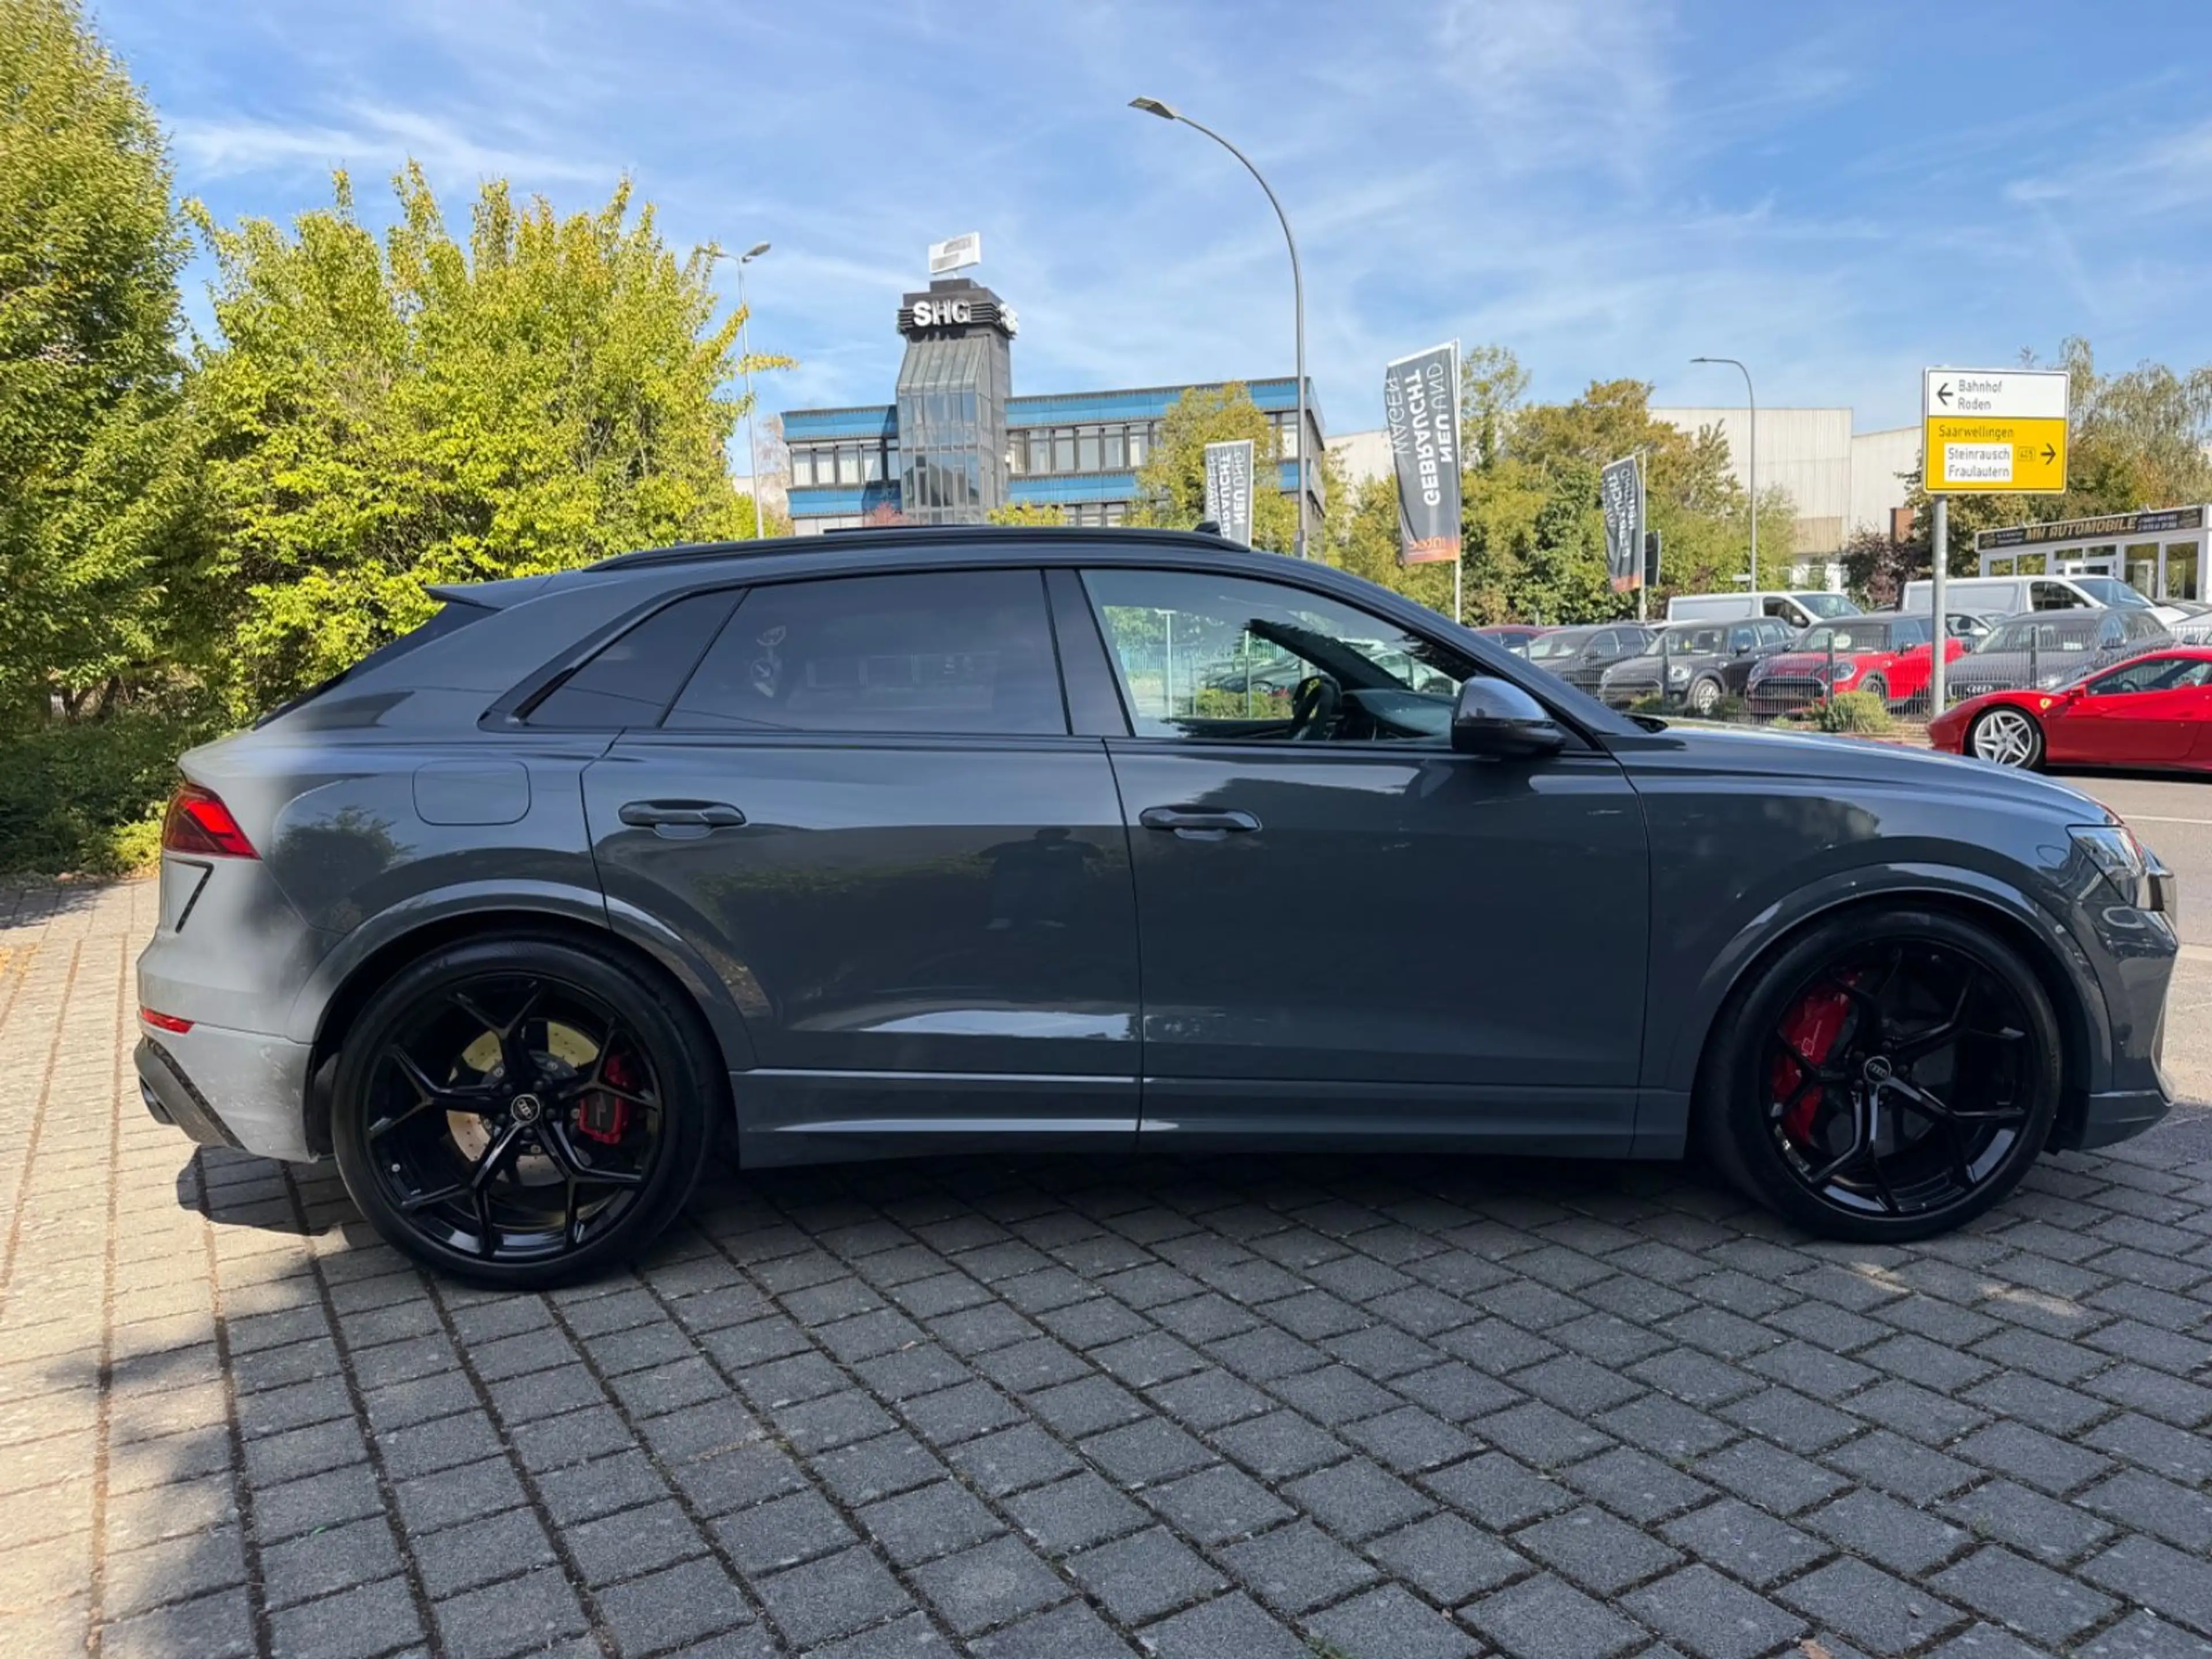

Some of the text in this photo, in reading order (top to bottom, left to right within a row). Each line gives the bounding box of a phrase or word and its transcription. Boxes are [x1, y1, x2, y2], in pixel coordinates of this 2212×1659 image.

[913, 298, 972, 327] SHG
[1958, 380, 2002, 392] Bahnhof
[1958, 398, 1991, 410] Roden
[1938, 425, 2014, 440] Saarwellingen
[1948, 448, 2010, 460] Steinrausch
[1948, 465, 2009, 478] Fraulautern
[2048, 517, 2138, 537] AUTOMOBILE
